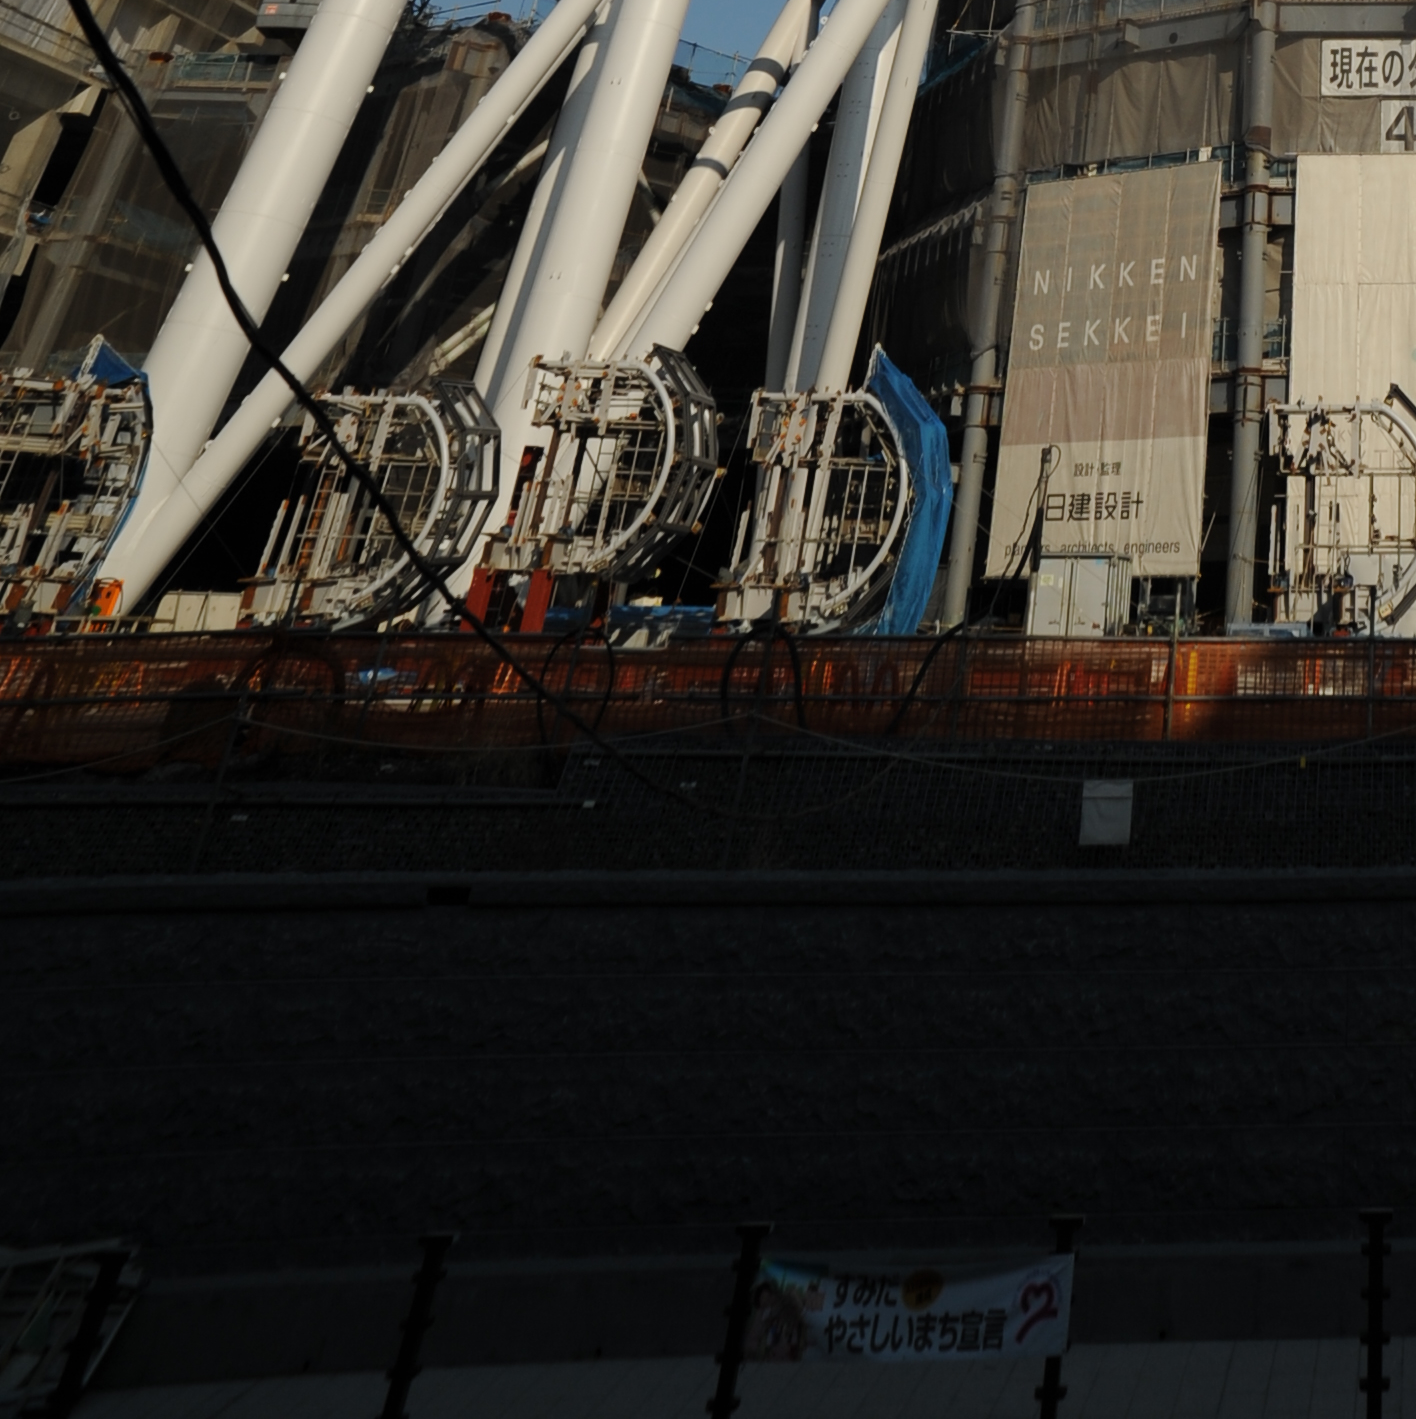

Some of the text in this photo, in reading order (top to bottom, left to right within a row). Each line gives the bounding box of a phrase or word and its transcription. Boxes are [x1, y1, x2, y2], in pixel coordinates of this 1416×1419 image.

[1033, 254, 1198, 296] NIKKEN
[1029, 311, 1188, 351] SEKKEI
[1045, 490, 1144, 523] 日建設計
[1124, 539, 1181, 557] engineers
[833, 1271, 901, 1310] すみだ
[824, 1308, 1008, 1355] やさしいまち宣言
